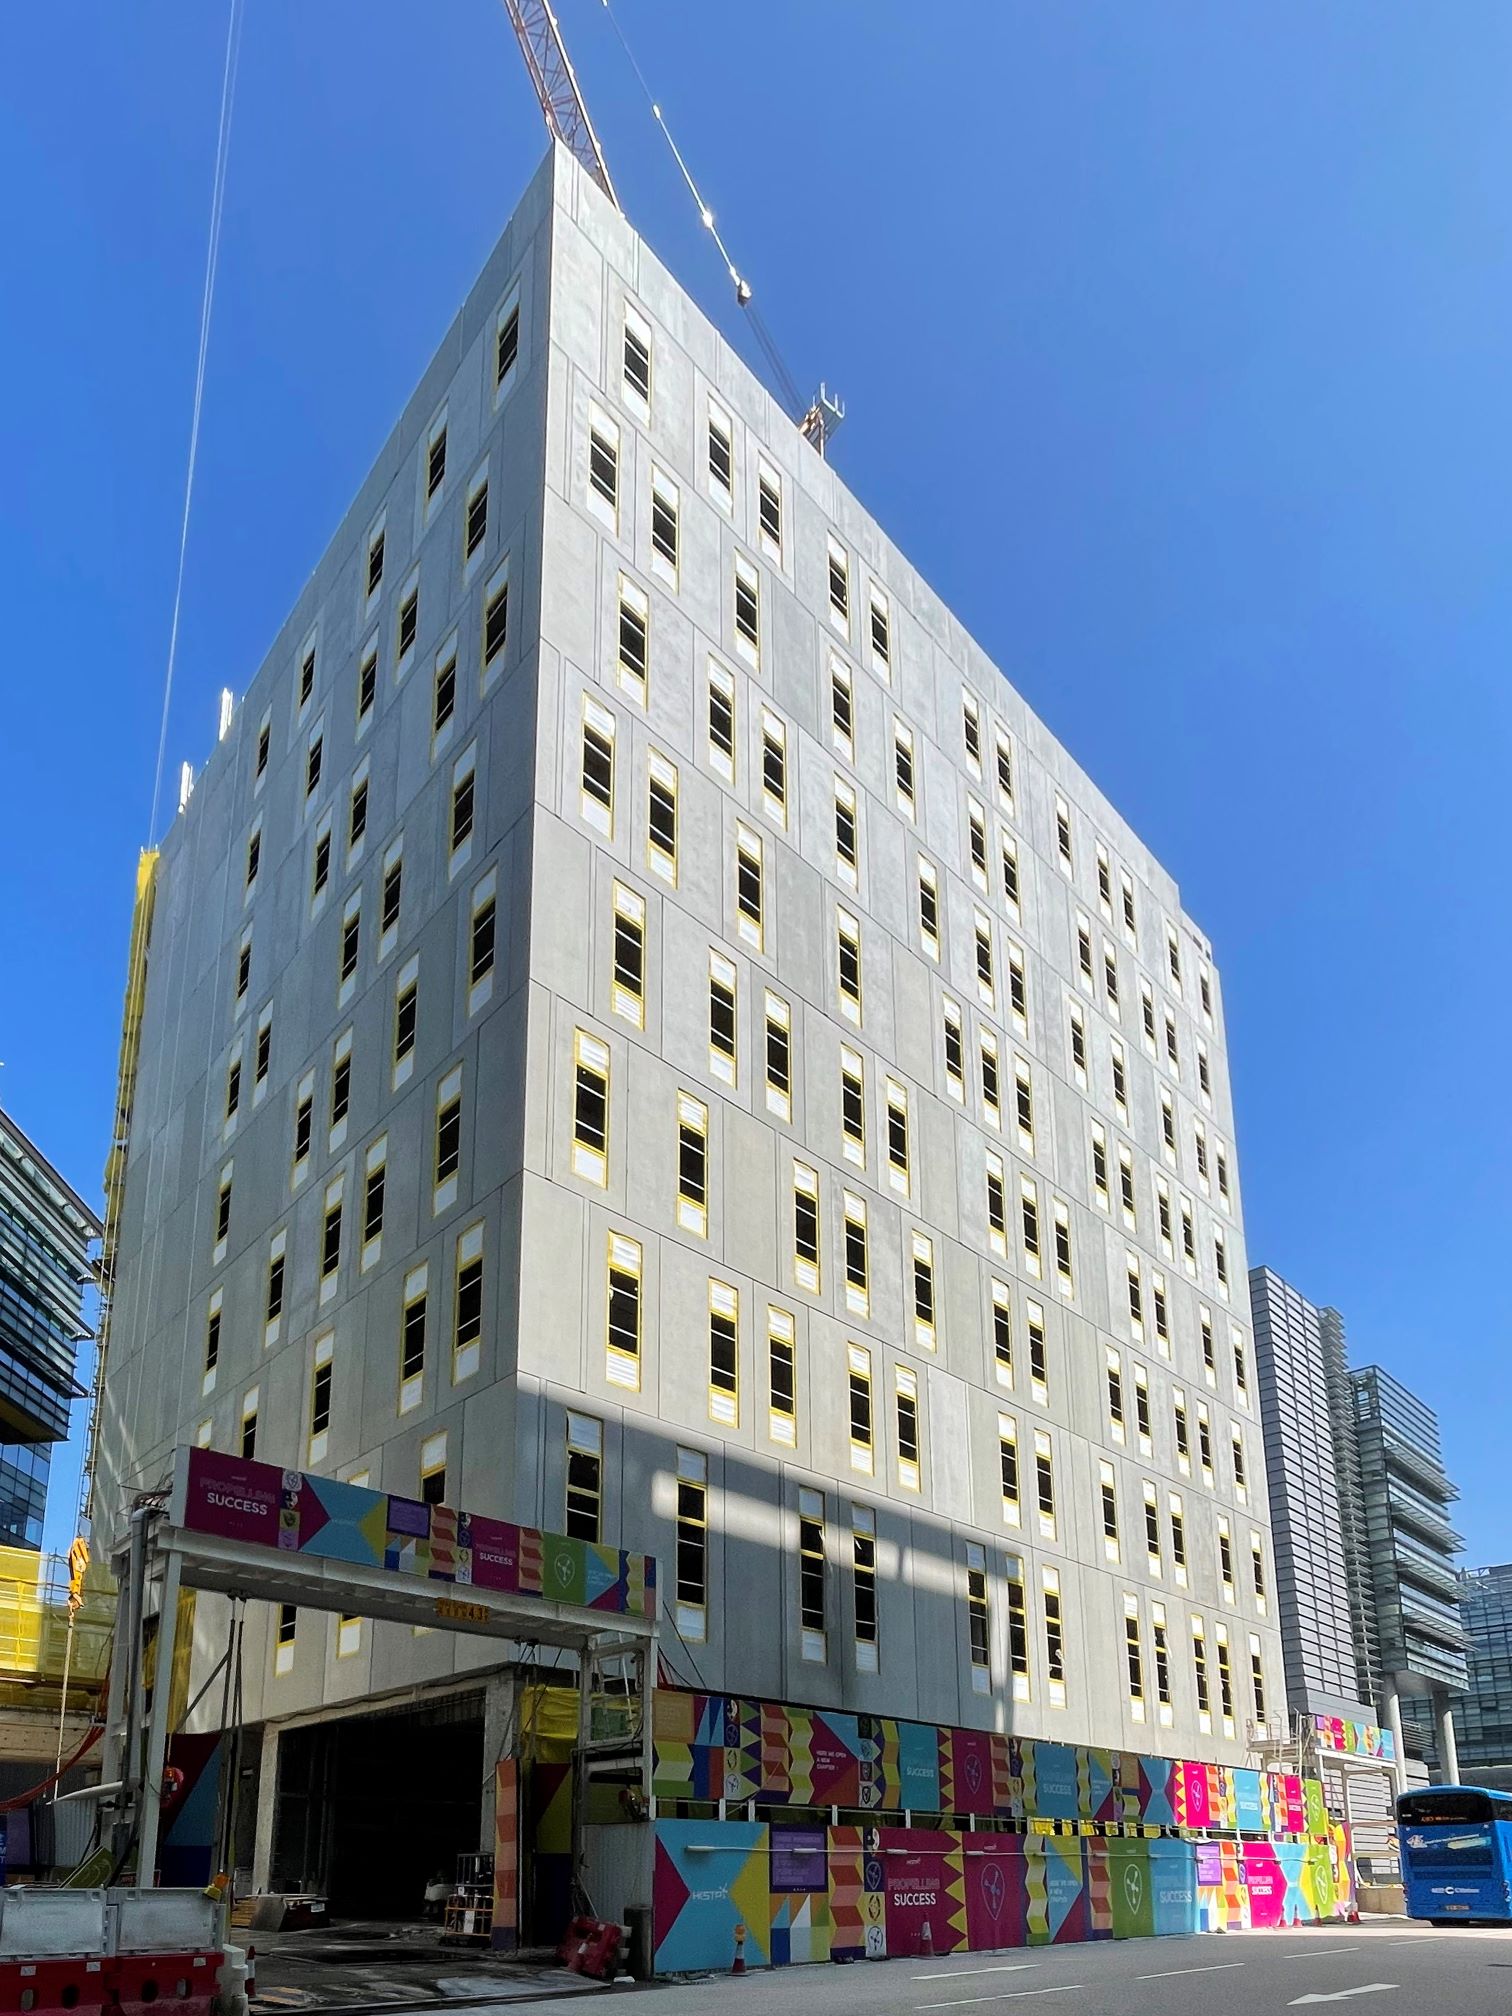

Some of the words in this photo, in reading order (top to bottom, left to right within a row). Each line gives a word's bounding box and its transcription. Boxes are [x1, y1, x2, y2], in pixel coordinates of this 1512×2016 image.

[207, 1492, 268, 1516] SUCCESS
[479, 1552, 513, 1566] SUCCESS
[893, 1893, 936, 1906] SUCCESS
